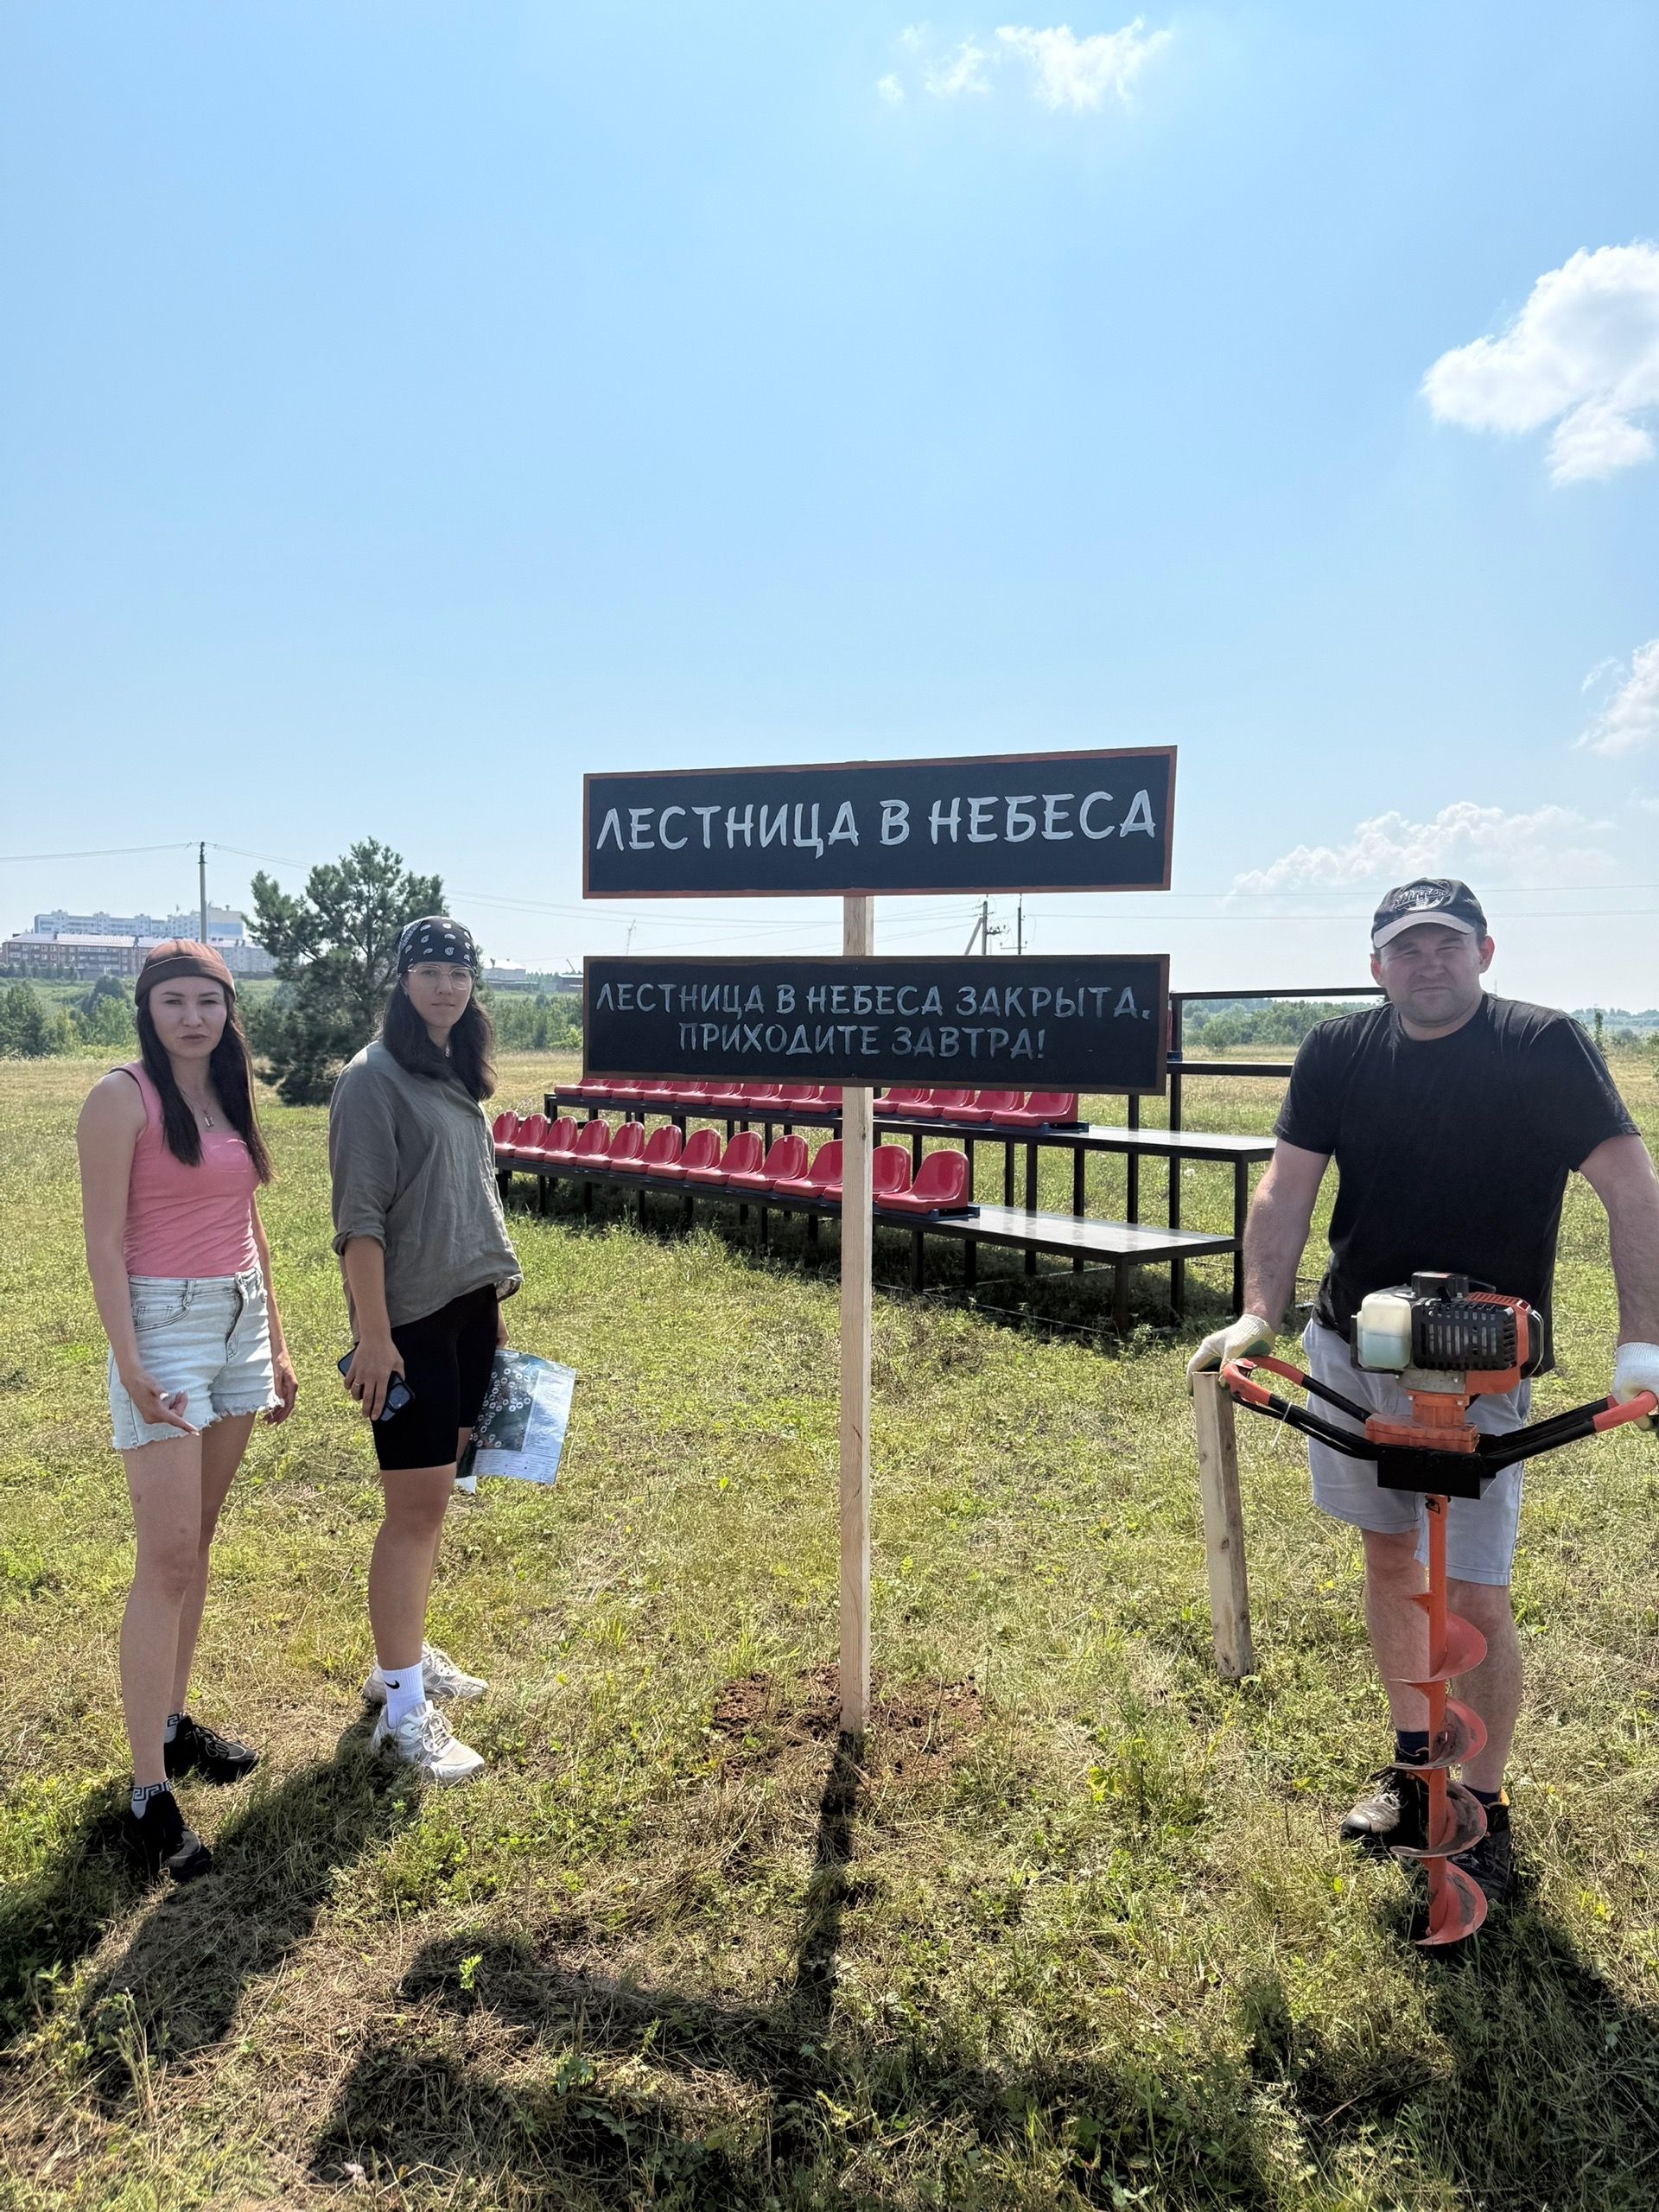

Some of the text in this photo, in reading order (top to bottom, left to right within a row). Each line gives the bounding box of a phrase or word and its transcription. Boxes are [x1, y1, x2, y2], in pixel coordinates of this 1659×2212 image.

[596, 789, 1156, 860] ЛЕСТНИЦА В НЕБЕСА
[596, 982, 1151, 1020] ЛЕСТНИЦА В НЕБЕСА ЗАКРЫТА.
[678, 1022, 1046, 1059] ПРИХОДИТЕ ЗАВТРА!
